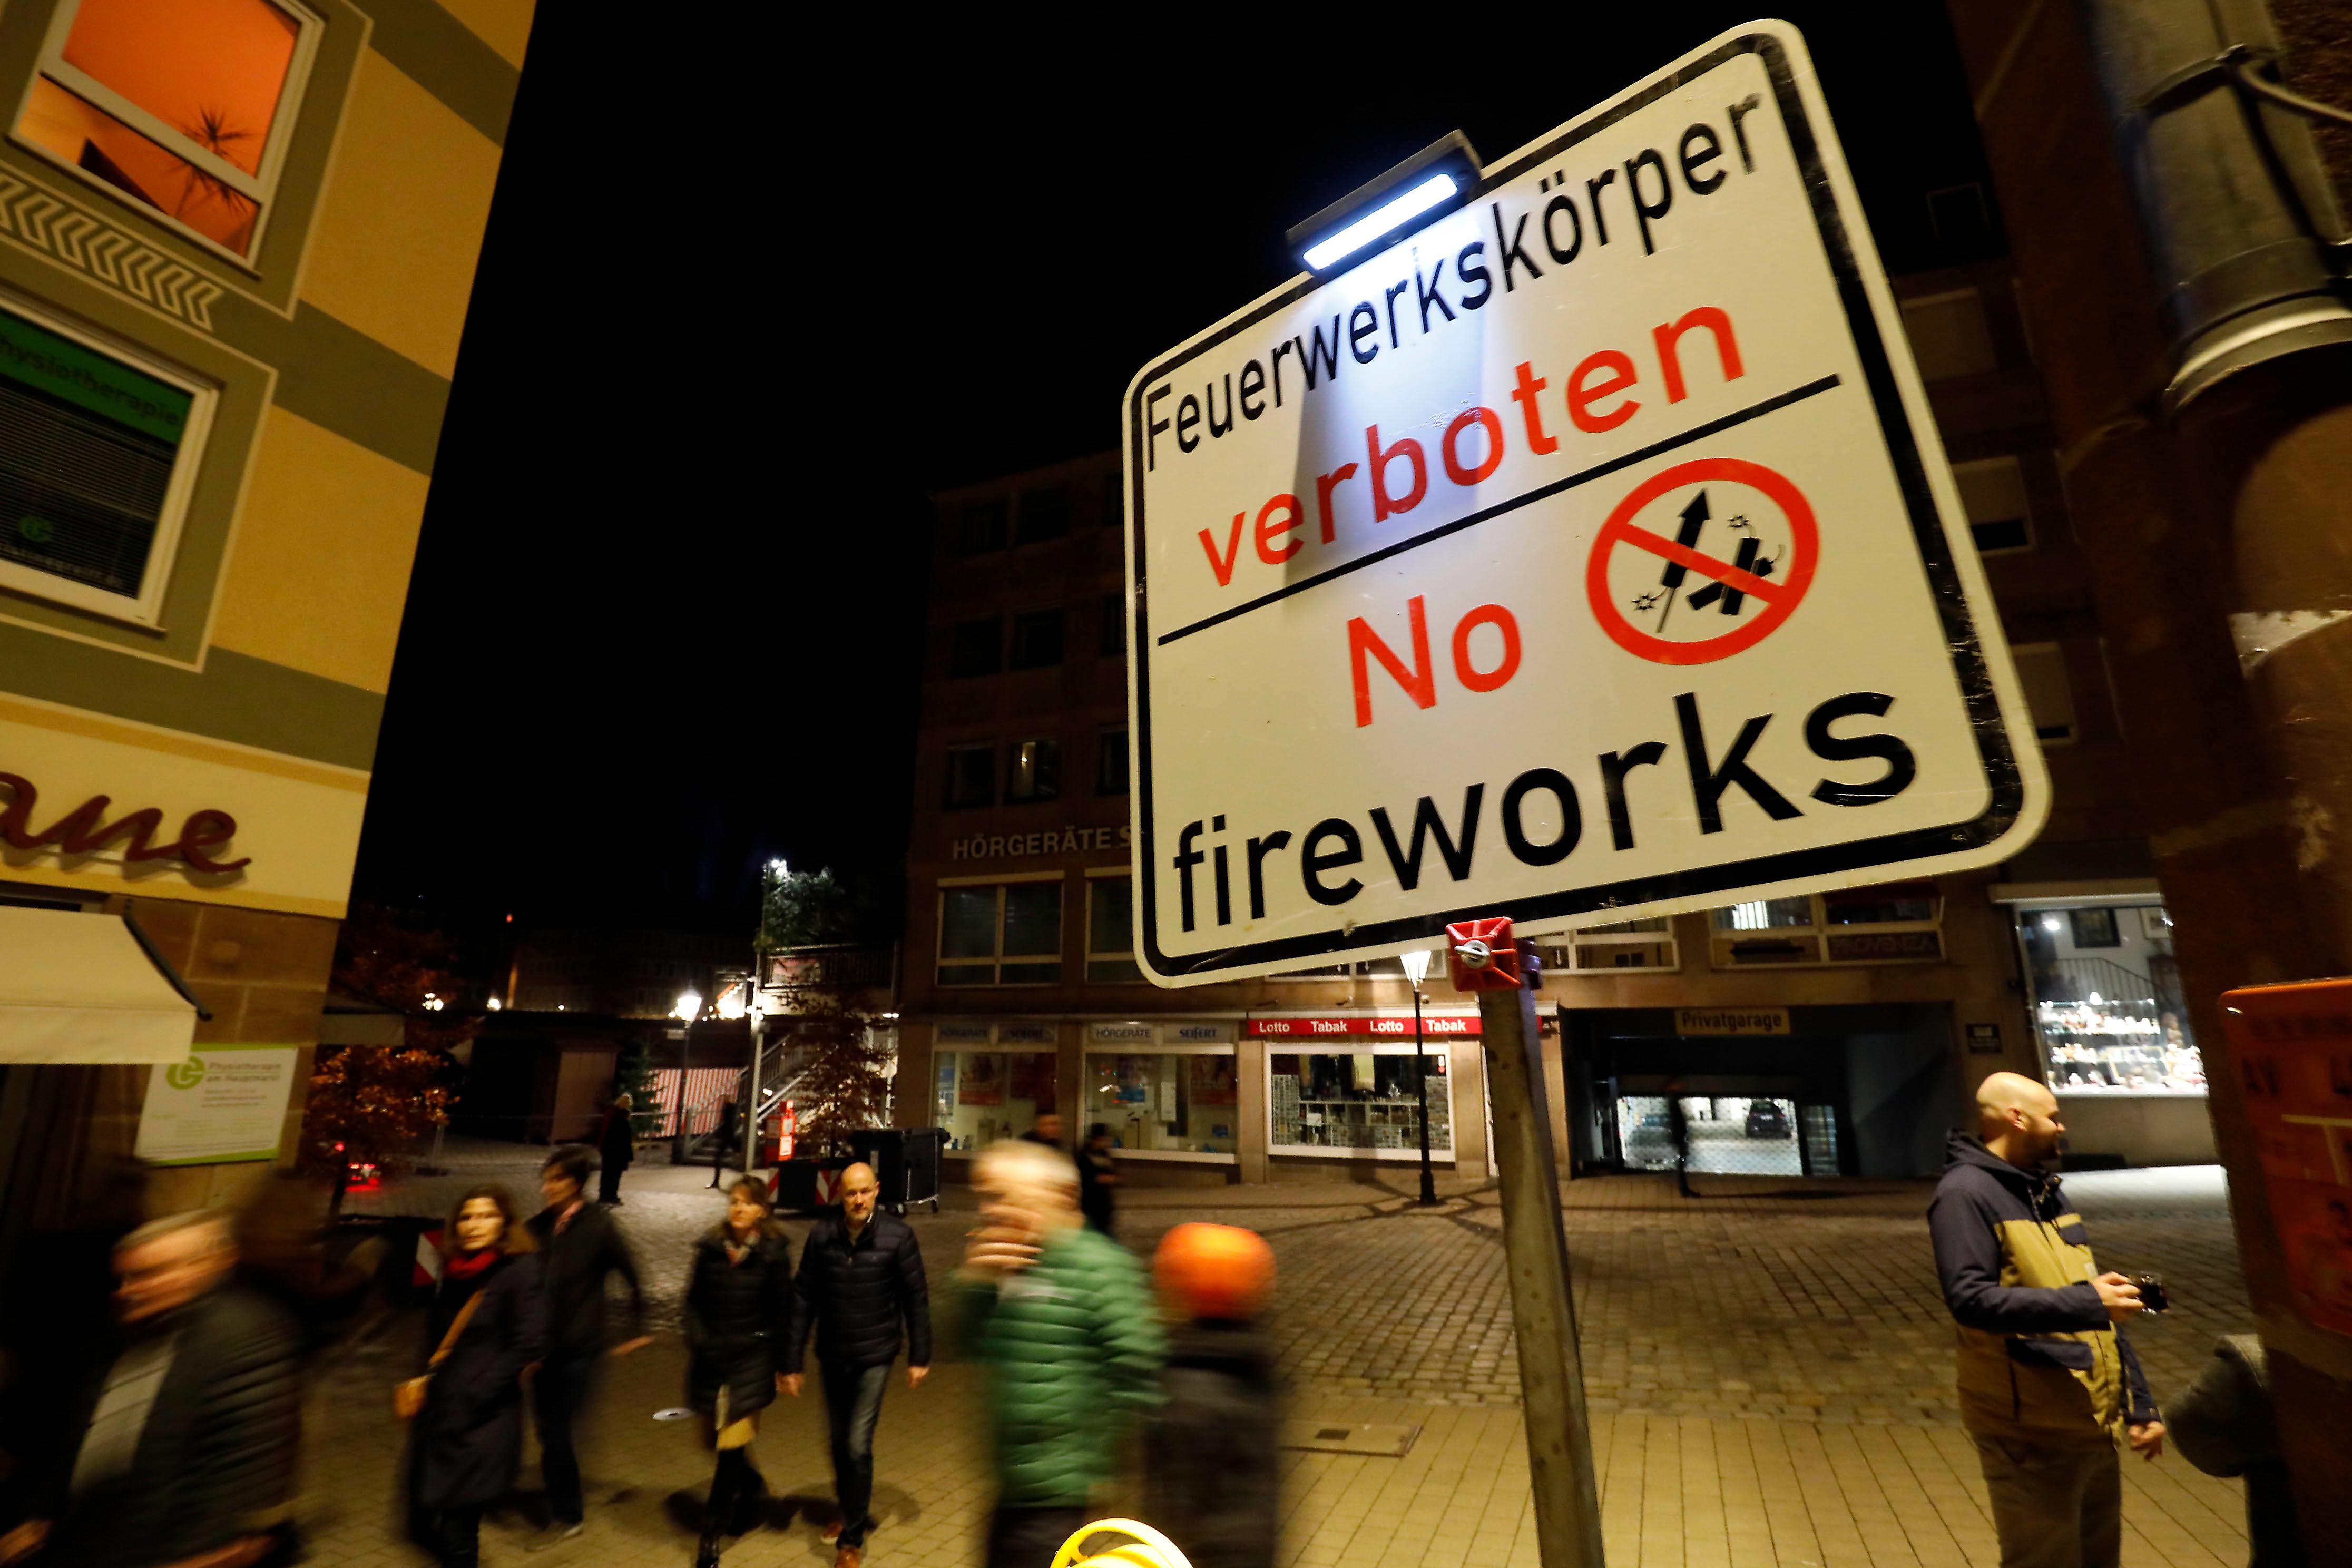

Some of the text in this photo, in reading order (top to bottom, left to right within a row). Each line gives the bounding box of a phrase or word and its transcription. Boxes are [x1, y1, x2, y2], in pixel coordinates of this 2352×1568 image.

[1144, 93, 1763, 472] Feuerwerkskörper
[1198, 306, 1745, 587] verboten
[1347, 595, 1522, 728] No
[953, 825, 1111, 860] HÖRGERÄTE
[1173, 691, 1917, 933] fireworks
[1096, 1026, 1151, 1038] HÖRGERÄTE
[1259, 1018, 1466, 1033] Lotto Tabak Lotto Tabak
[1682, 1012, 1782, 1031] Privatgarage
